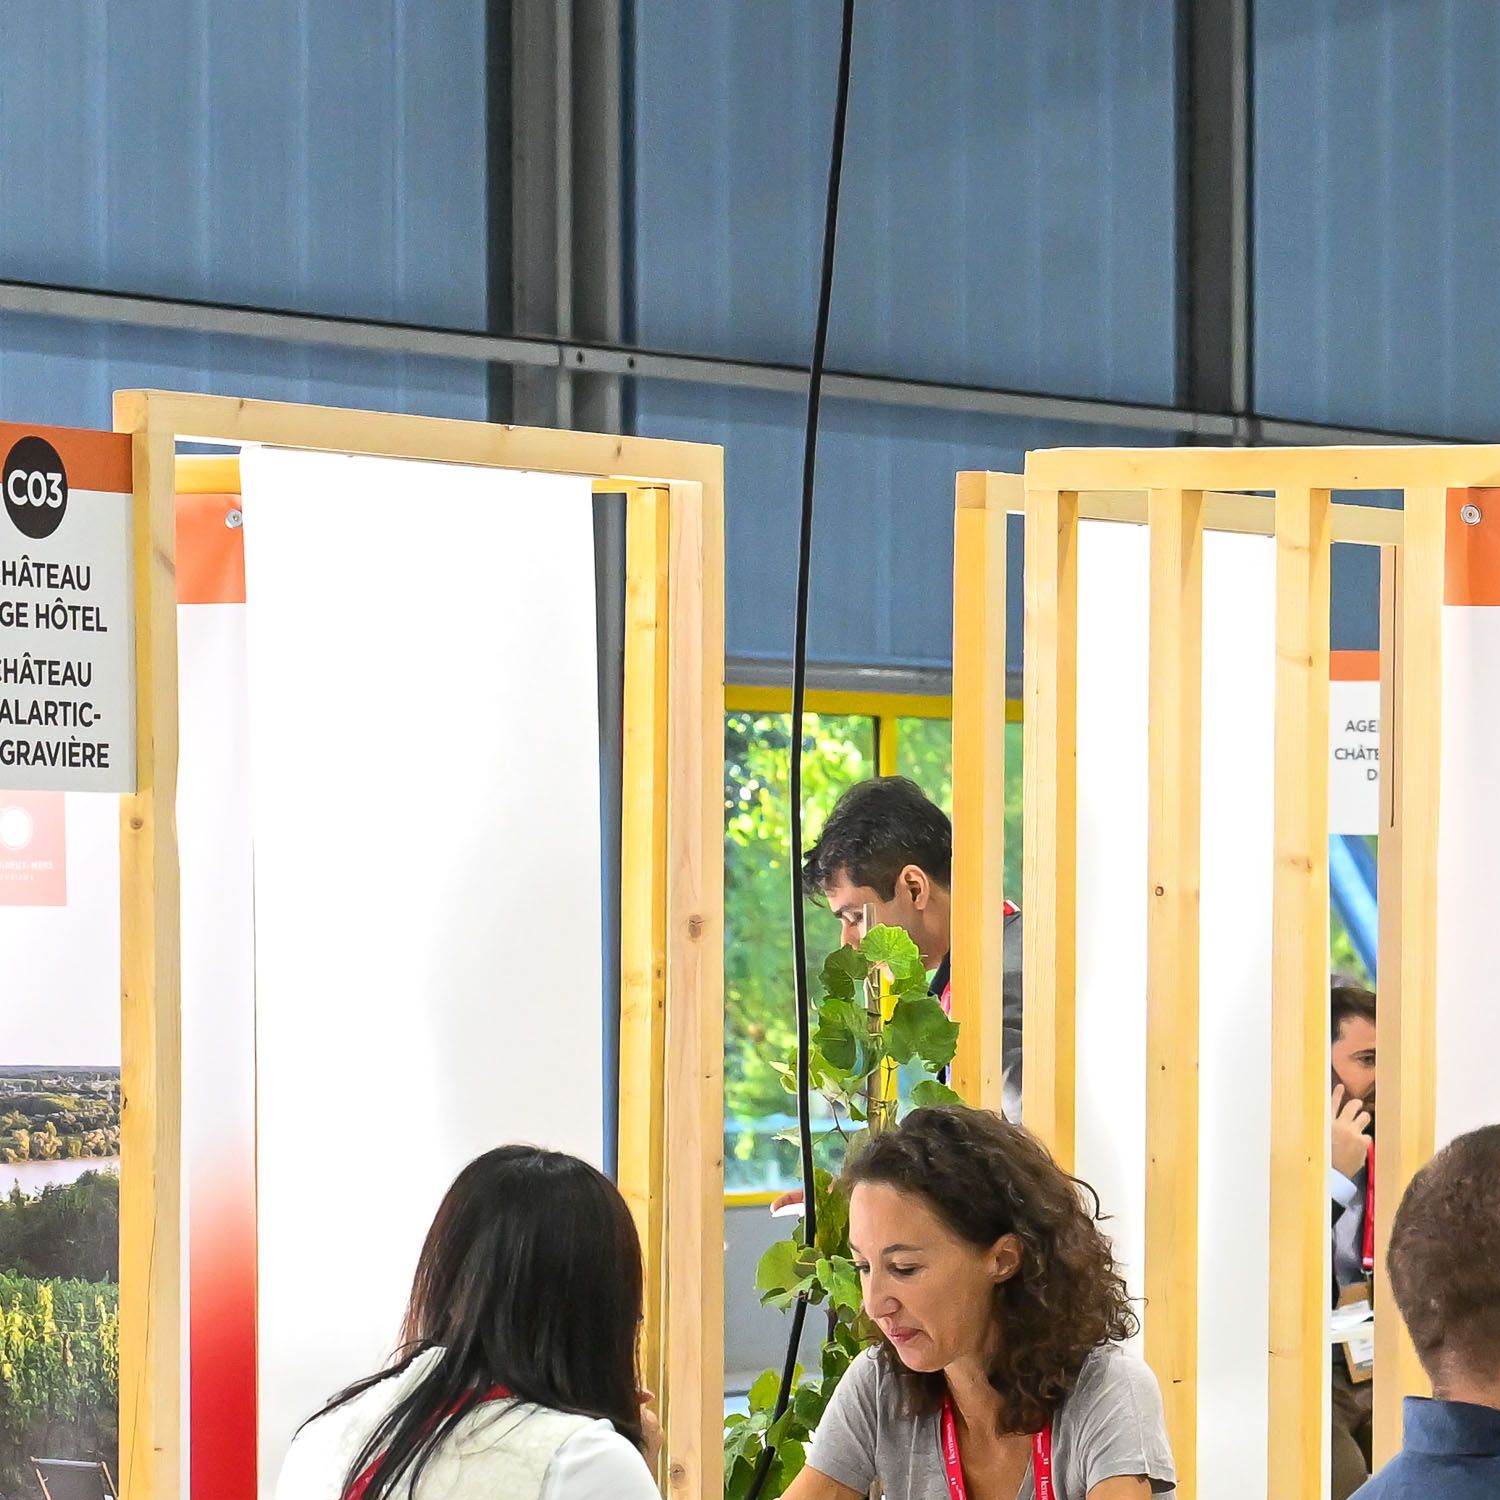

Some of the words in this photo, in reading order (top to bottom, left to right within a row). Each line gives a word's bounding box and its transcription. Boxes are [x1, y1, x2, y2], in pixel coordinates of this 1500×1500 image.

[8, 470, 63, 508] C03
[0, 555, 91, 591] HÂTEAU
[36, 597, 108, 632] HÔTEL
[0, 652, 92, 687] HÂTEAU
[1345, 720, 1380, 733] AGE
